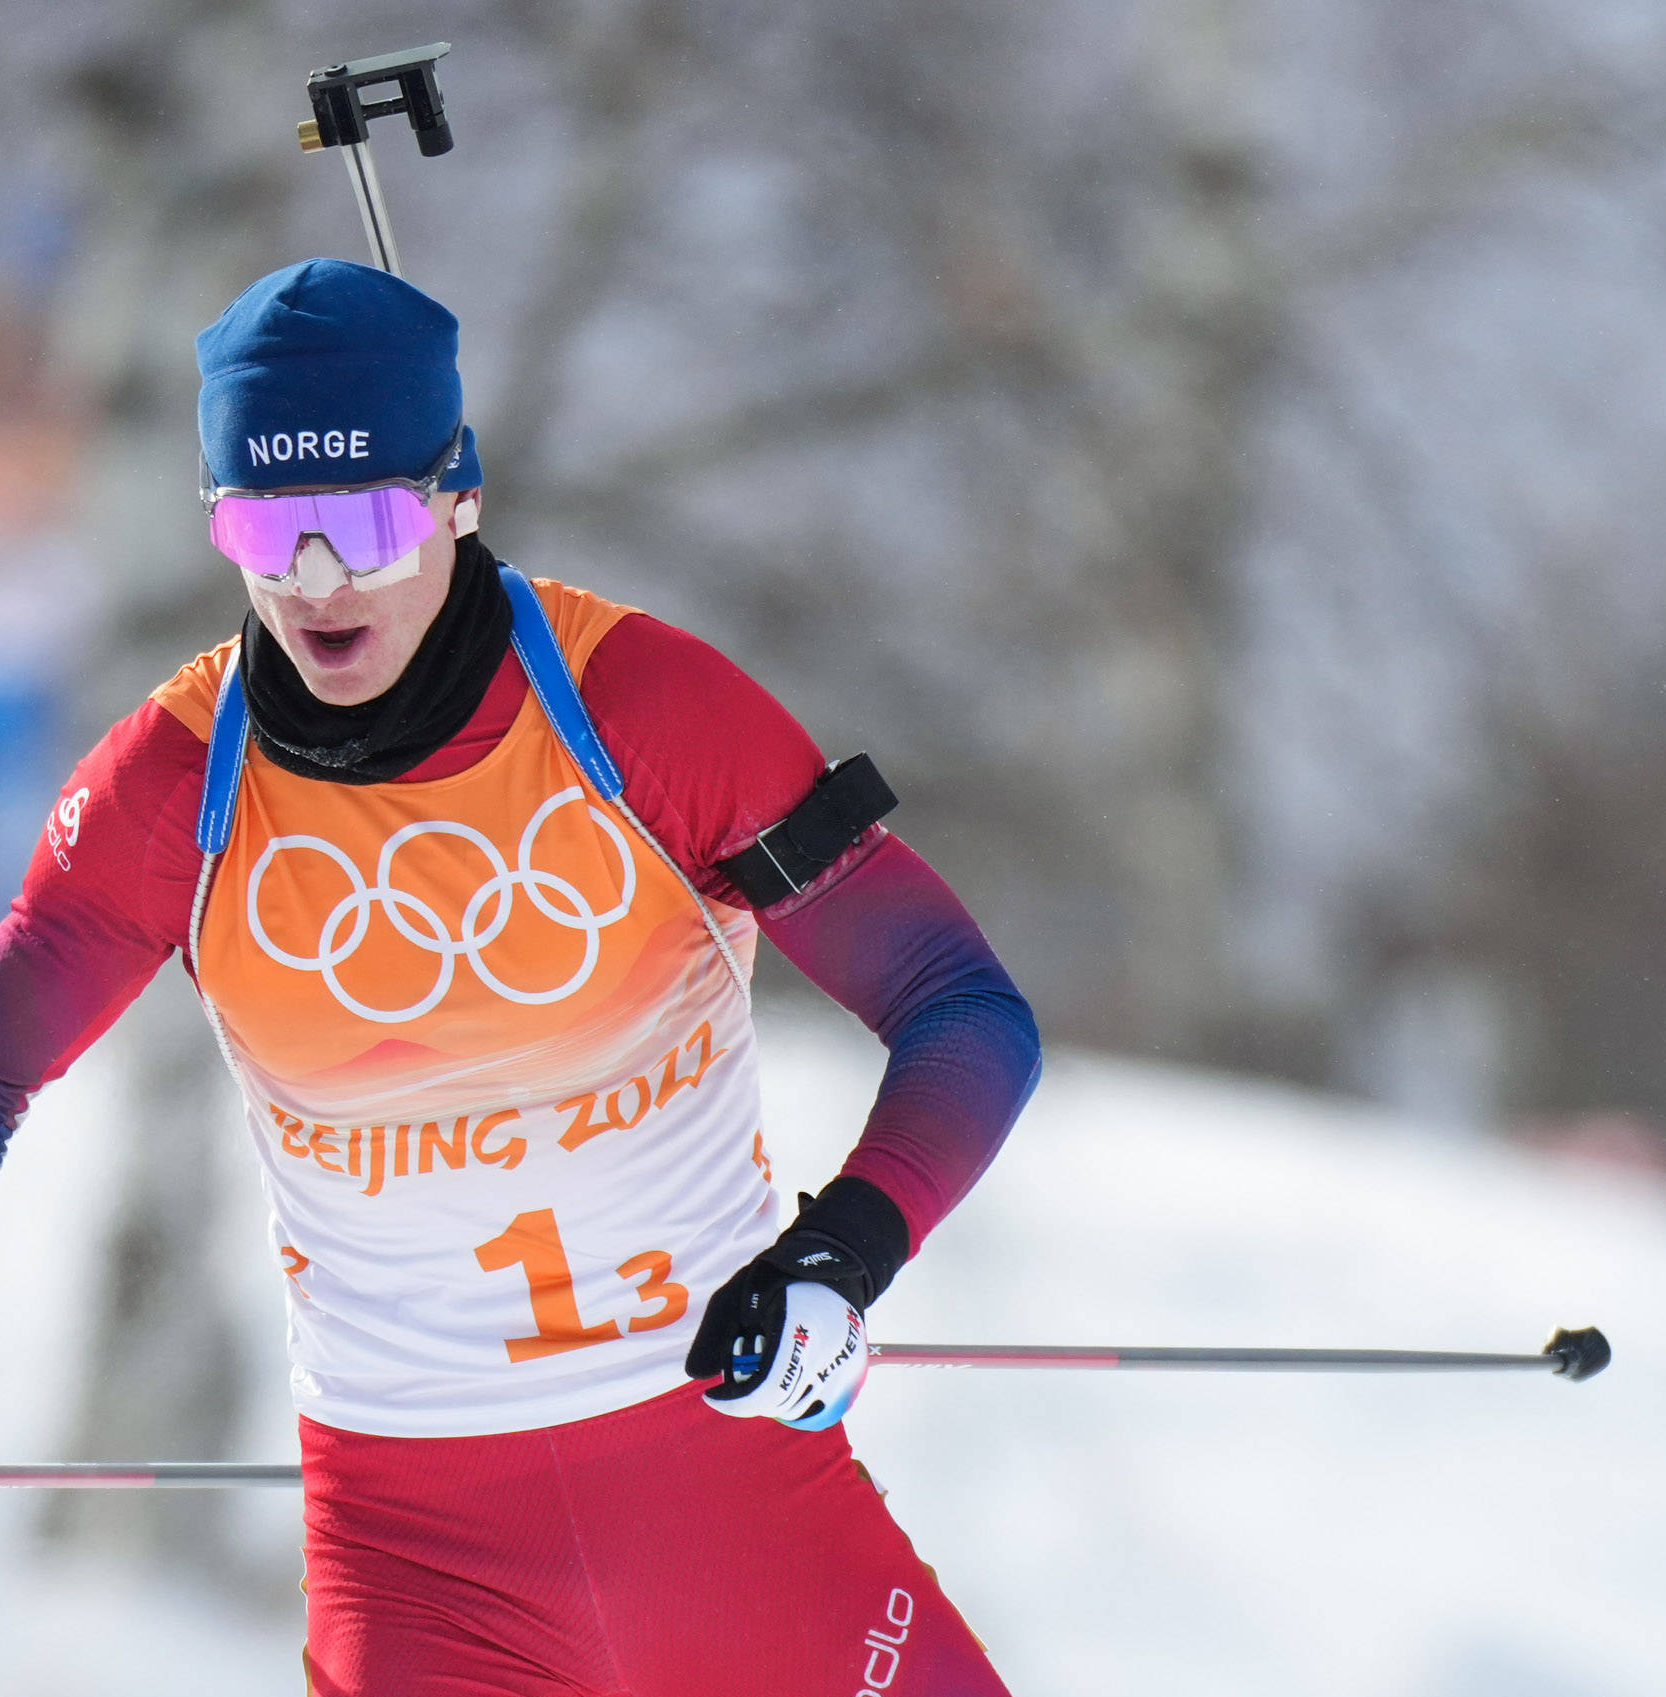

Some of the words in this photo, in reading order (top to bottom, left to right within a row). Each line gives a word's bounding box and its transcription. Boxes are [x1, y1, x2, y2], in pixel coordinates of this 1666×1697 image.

[247, 430, 370, 467] NORGE
[47, 811, 71, 872] odlo
[268, 1101, 527, 1197] BEIJING
[554, 1021, 729, 1152] 2022
